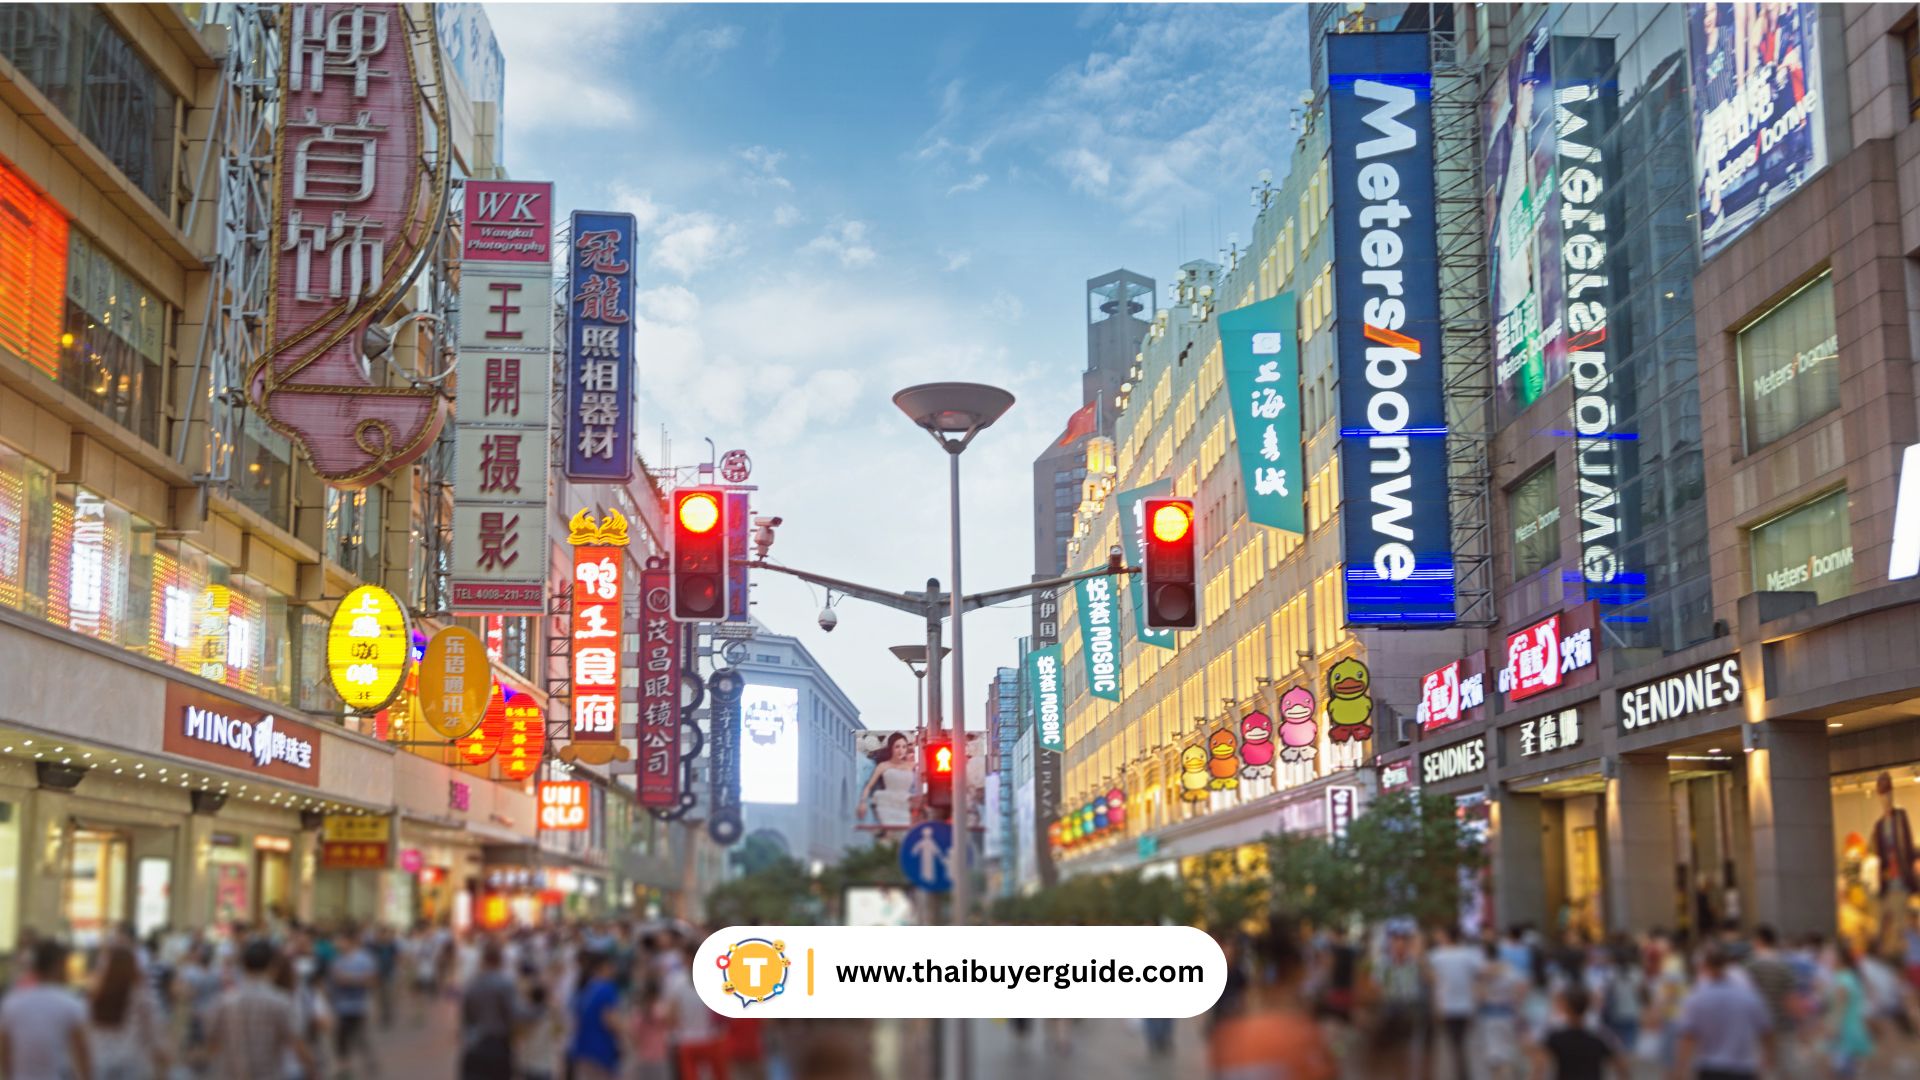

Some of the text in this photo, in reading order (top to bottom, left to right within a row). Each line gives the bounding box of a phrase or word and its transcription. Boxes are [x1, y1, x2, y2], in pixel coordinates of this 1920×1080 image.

[468, 239, 545, 255] Photography
[481, 227, 535, 240] Wangkai
[1353, 78, 1422, 581] Meters/bonwe
[574, 557, 618, 732] 鸭王食府
[1560, 627, 1593, 675] 火锅
[644, 619, 674, 777] 茂昌眼镜公司
[1621, 658, 1741, 730] SENDNES
[185, 705, 252, 752] MINGR
[1423, 738, 1486, 784] SENDNES
[541, 805, 585, 825] QLO
[542, 786, 581, 806] UNI
